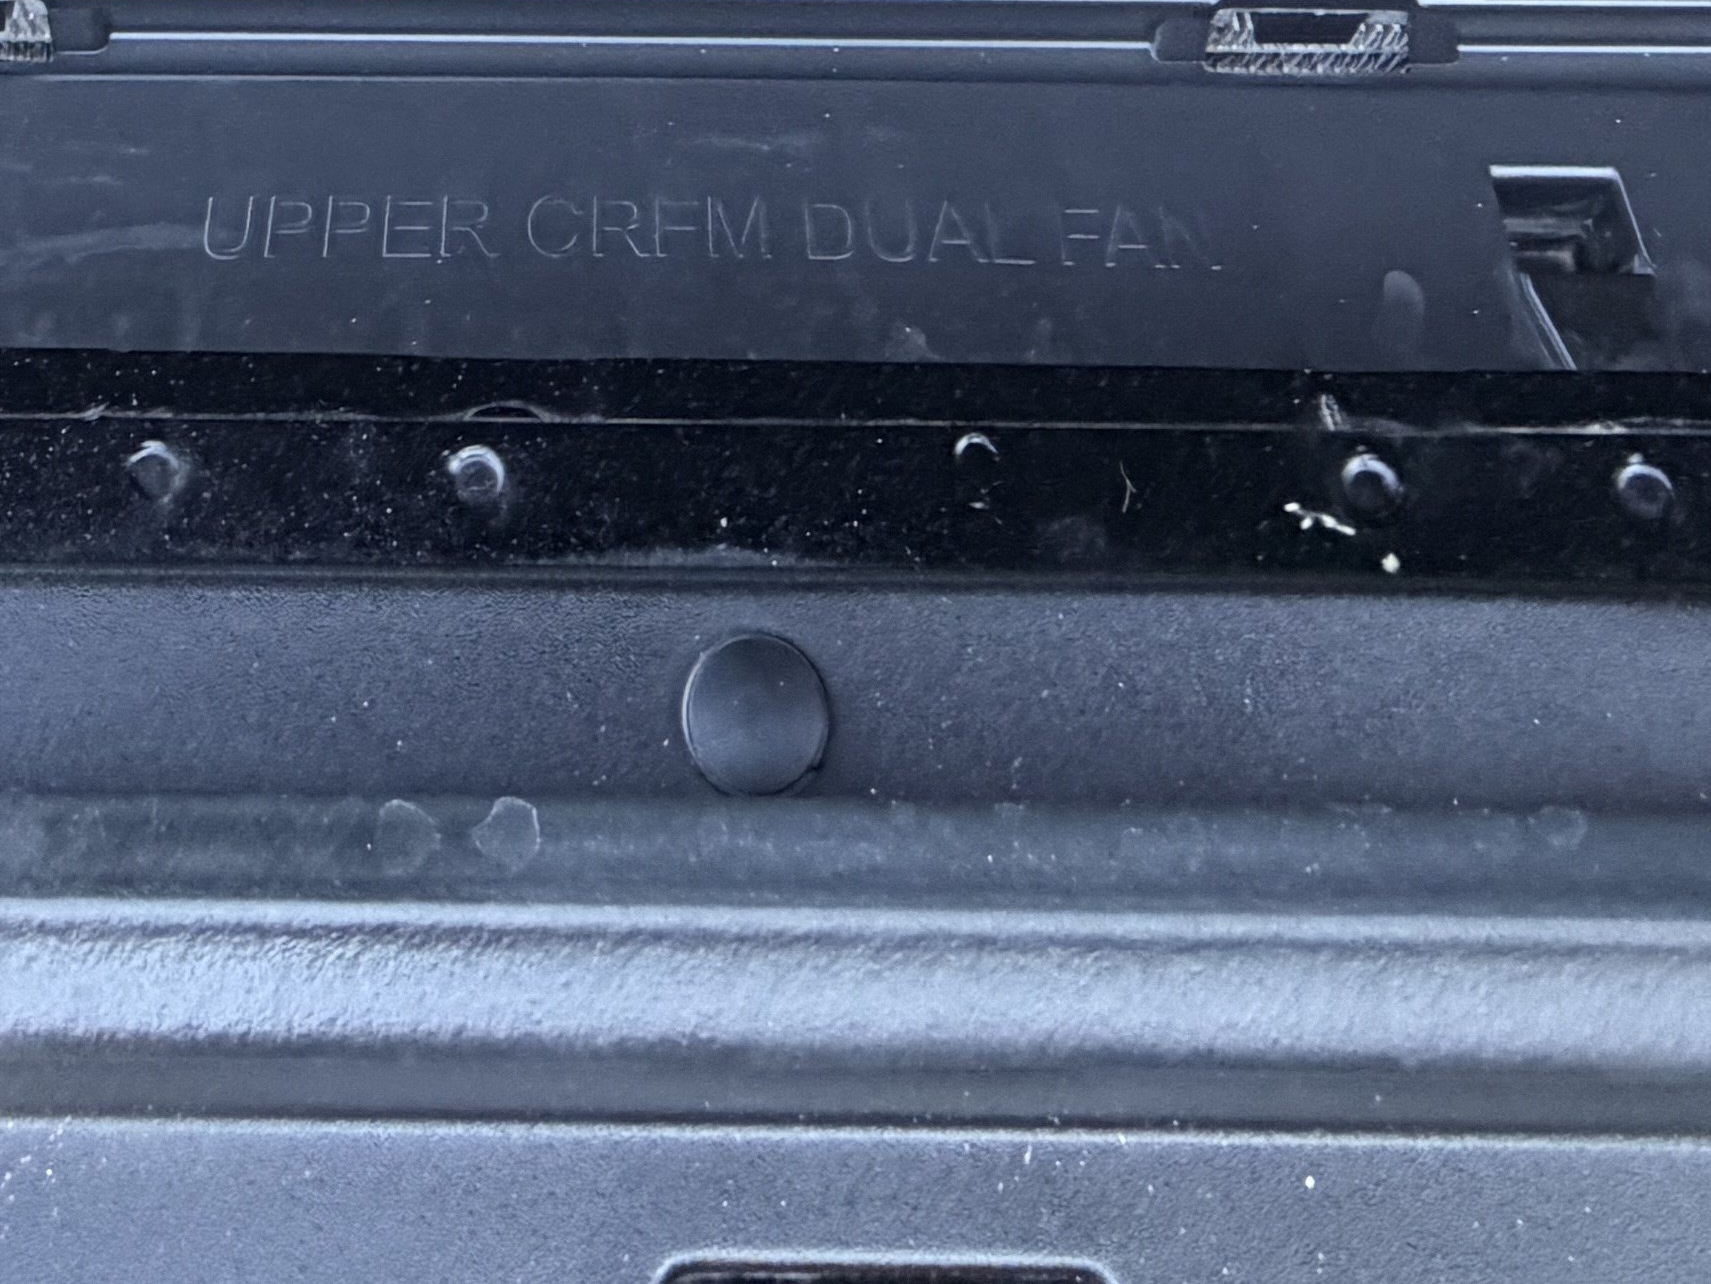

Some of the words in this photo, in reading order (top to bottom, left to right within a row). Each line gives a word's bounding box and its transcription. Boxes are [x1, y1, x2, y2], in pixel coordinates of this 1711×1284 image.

[203, 194, 500, 261] UPPER
[526, 194, 772, 259] CRFM
[802, 197, 1036, 266] DUAL
[1055, 201, 1224, 271] FAN
